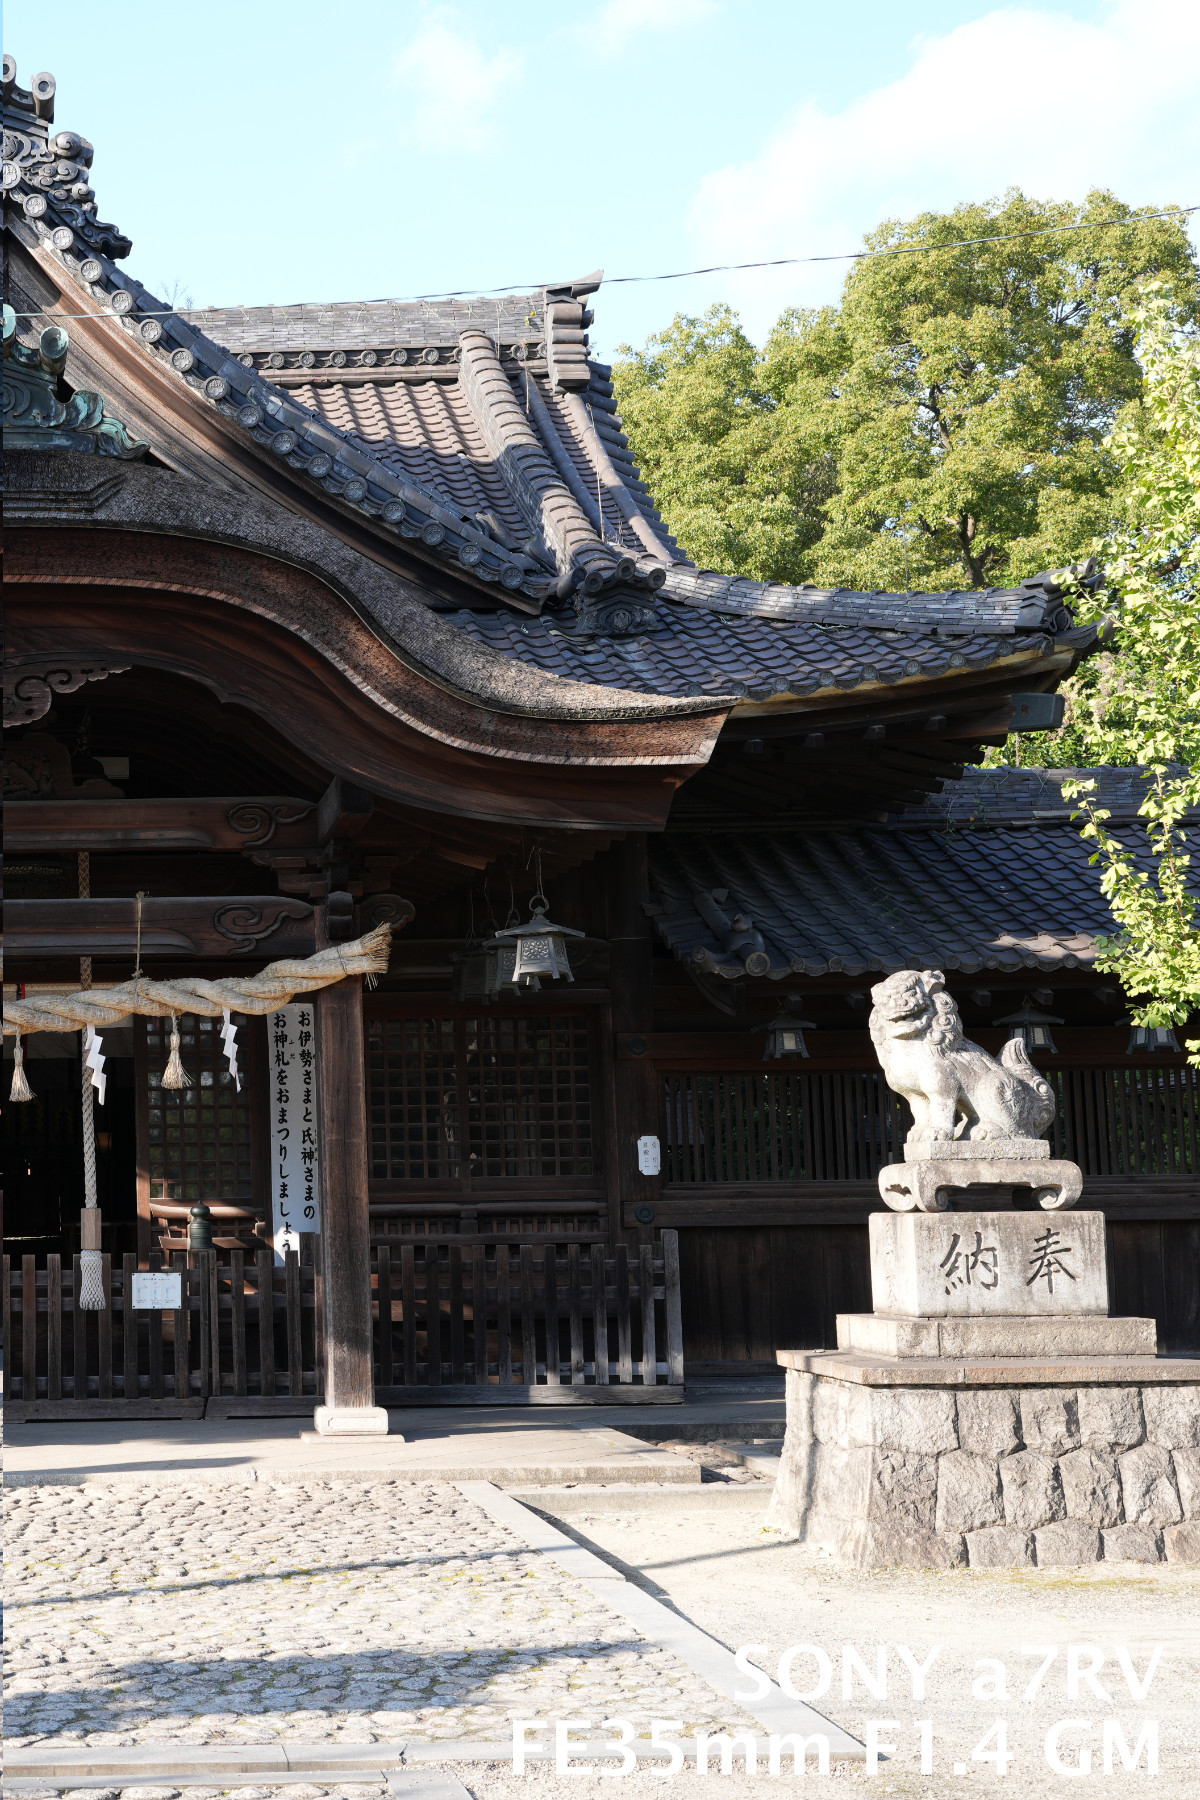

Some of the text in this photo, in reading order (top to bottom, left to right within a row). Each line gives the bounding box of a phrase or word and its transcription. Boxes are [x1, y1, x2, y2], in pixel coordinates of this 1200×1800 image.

[273, 1013, 292, 1251] お神札をおまつりしましょう
[297, 1011, 315, 1220] お伊勢さまと氏神さまの
